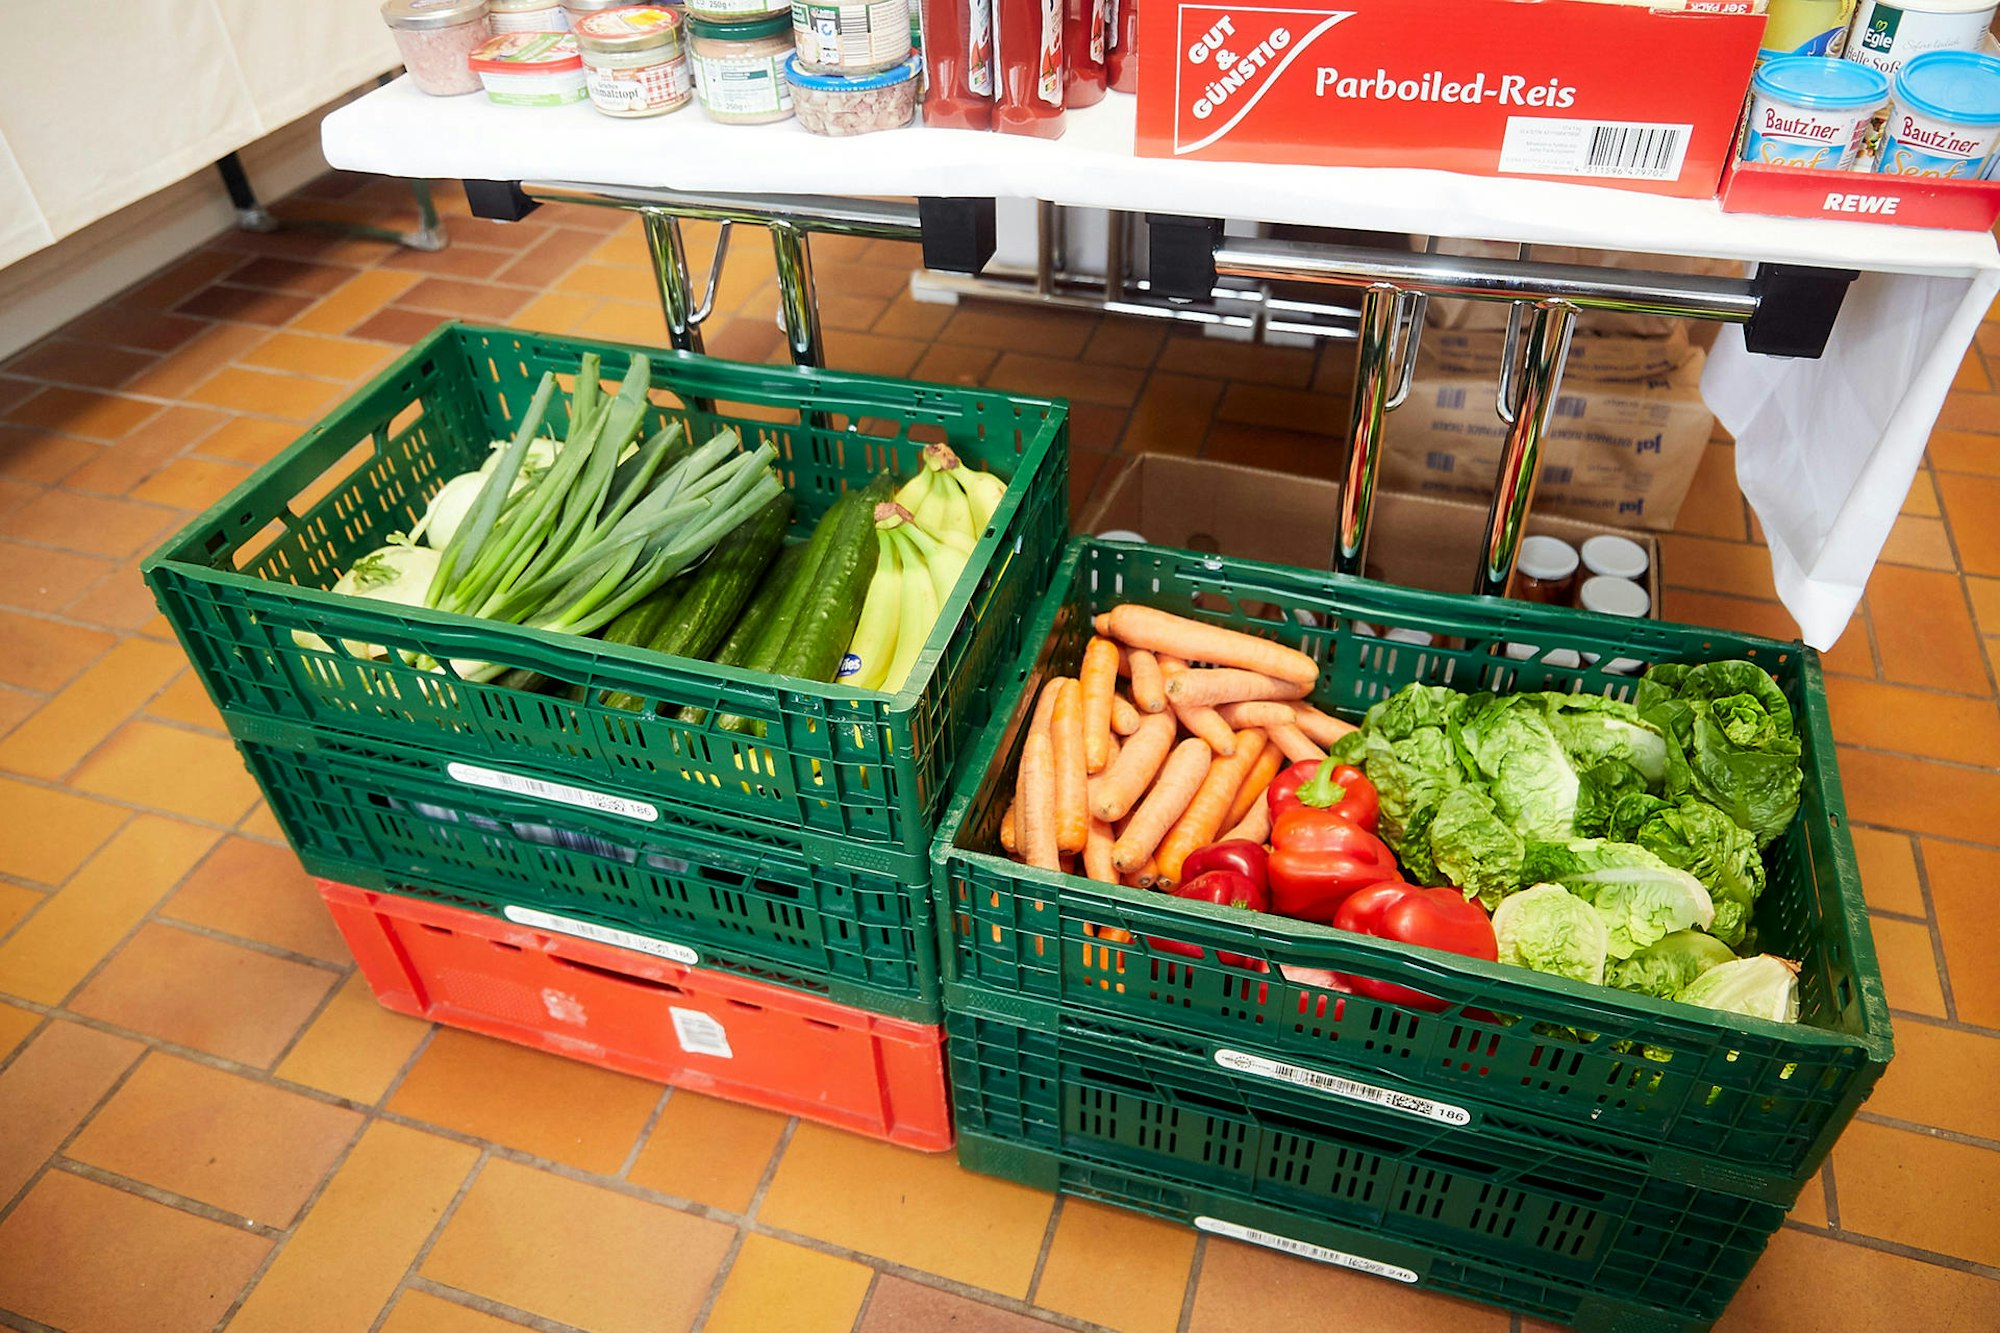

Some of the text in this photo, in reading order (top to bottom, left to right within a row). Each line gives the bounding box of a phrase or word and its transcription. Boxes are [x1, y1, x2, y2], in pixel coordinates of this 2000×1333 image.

[1690, 2, 1748, 13] 3er PACK
[1188, 14, 1236, 64] GUT
[1865, 29, 1893, 49] Egle
[1215, 49, 1240, 71] &
[1872, 57, 1902, 74] Soß
[1192, 27, 1291, 120] GÜNSTIG
[1315, 66, 1577, 108] Parboiled-Reis
[1765, 108, 1841, 140] Bautz'ner
[1902, 116, 1980, 153] Bautz'ner
[1823, 193, 1901, 215] REWE
[1637, 432, 1662, 455] ja!
[1439, 1108, 1465, 1122] 186
